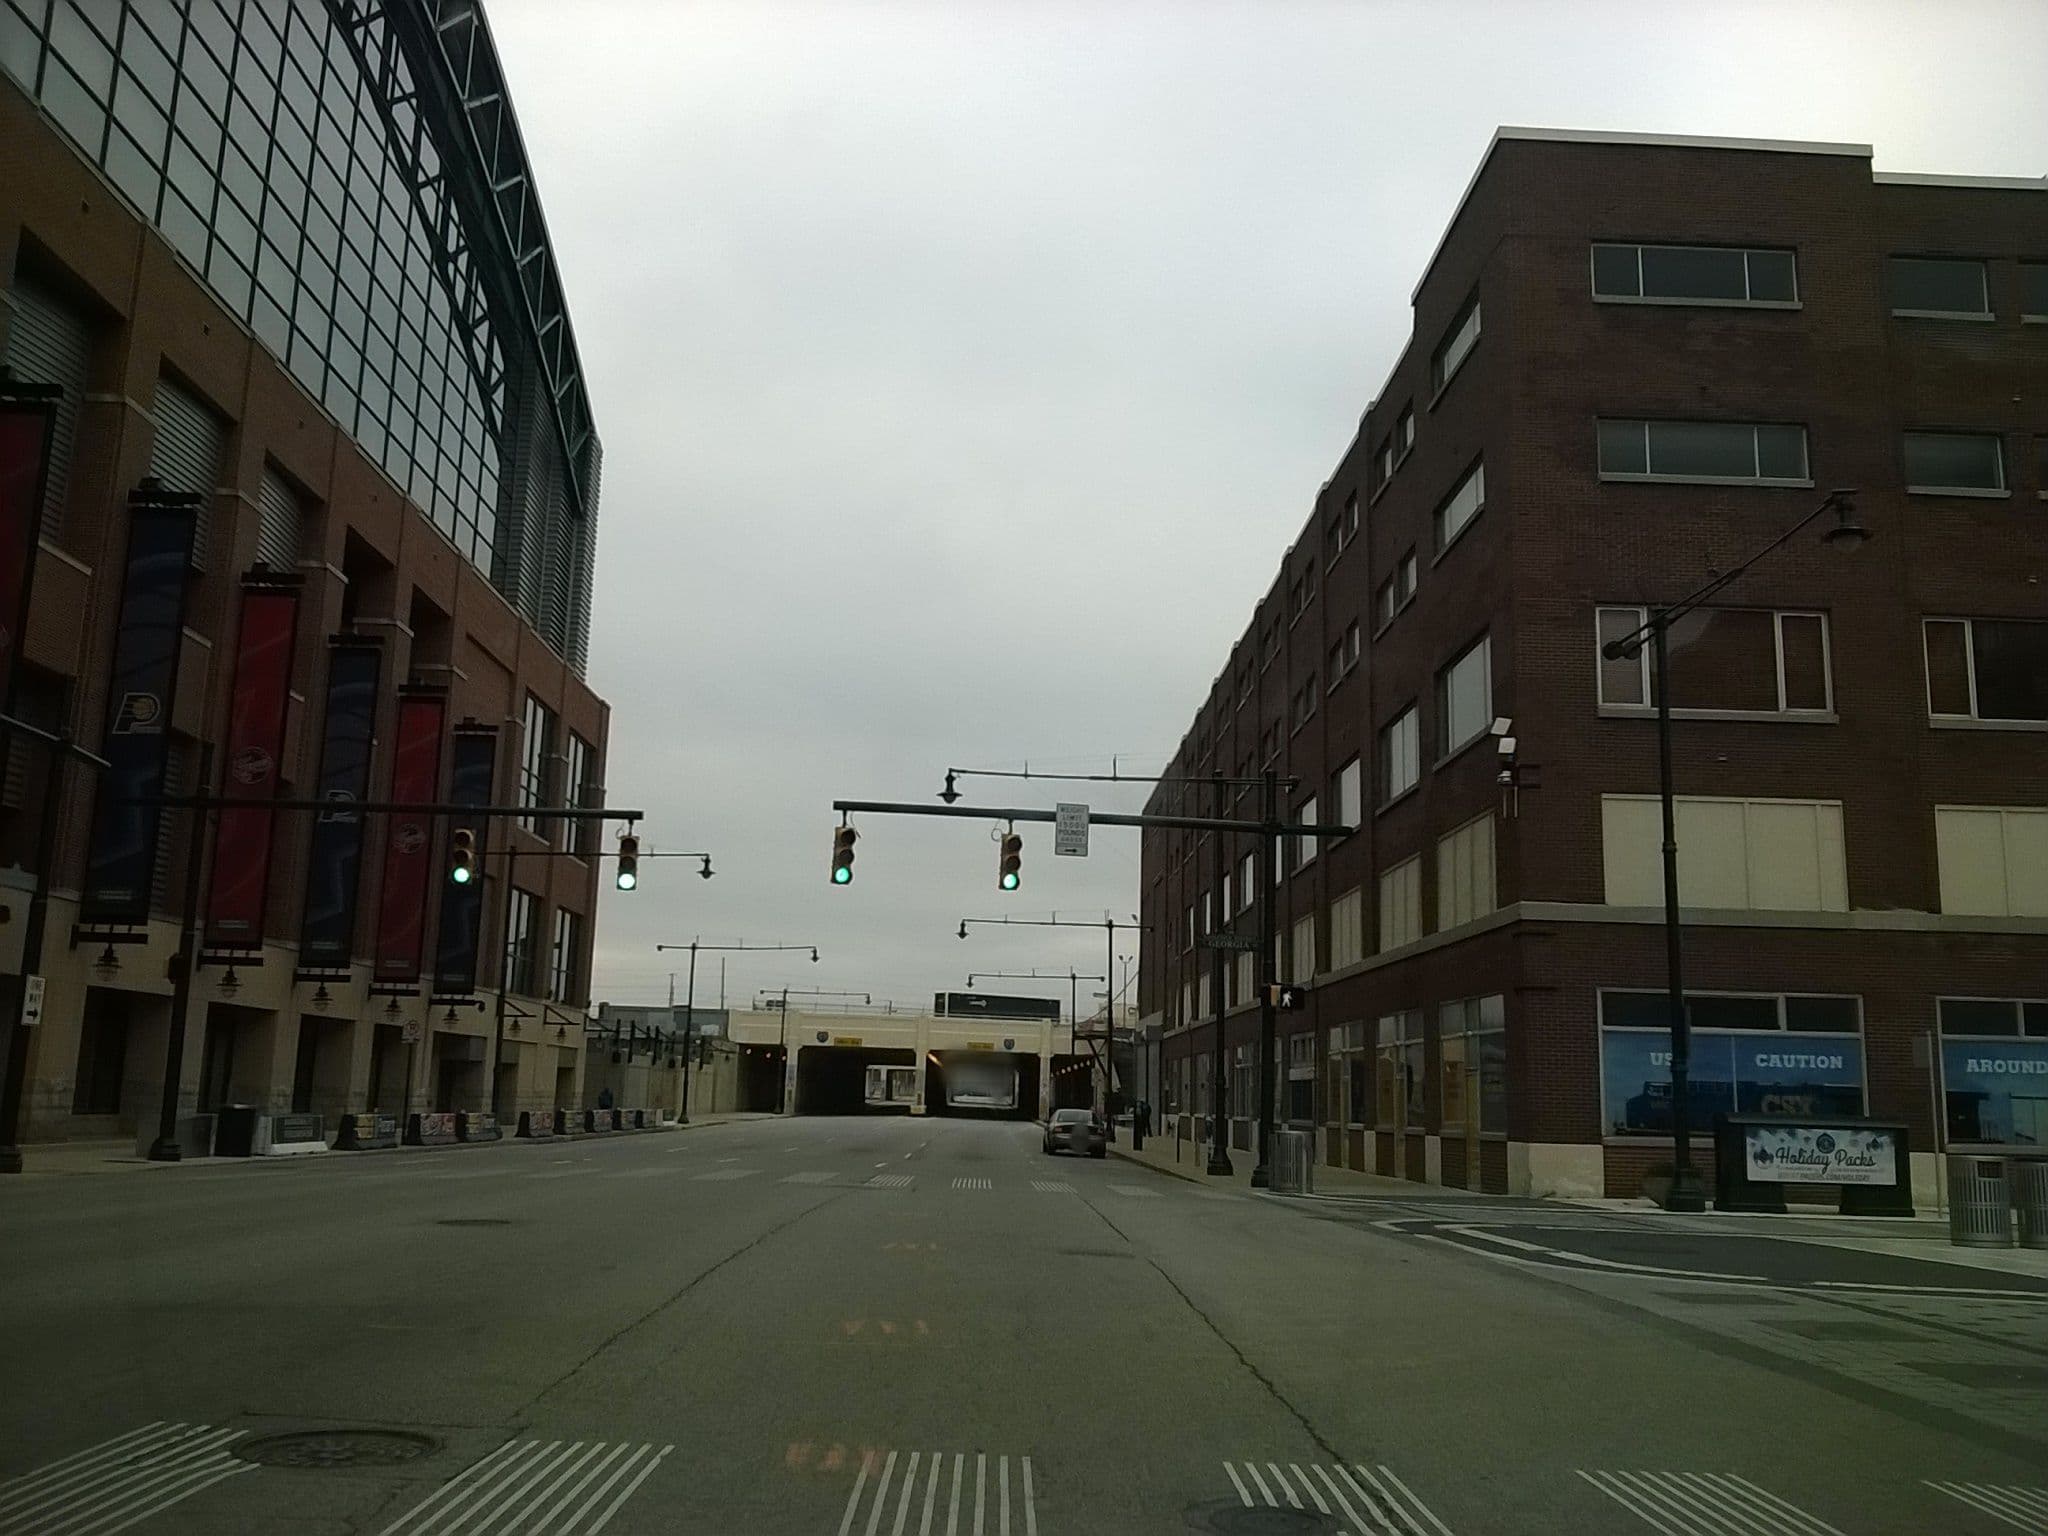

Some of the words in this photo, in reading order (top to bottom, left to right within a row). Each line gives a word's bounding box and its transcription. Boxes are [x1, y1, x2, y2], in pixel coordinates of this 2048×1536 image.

[1650, 1052, 1673, 1066] US
[1756, 1054, 1843, 1069] CAUTION
[1966, 1058, 2048, 1075] AROUND
[1775, 1146, 1832, 1174] Holiday
[1834, 1149, 1877, 1167] Packs
